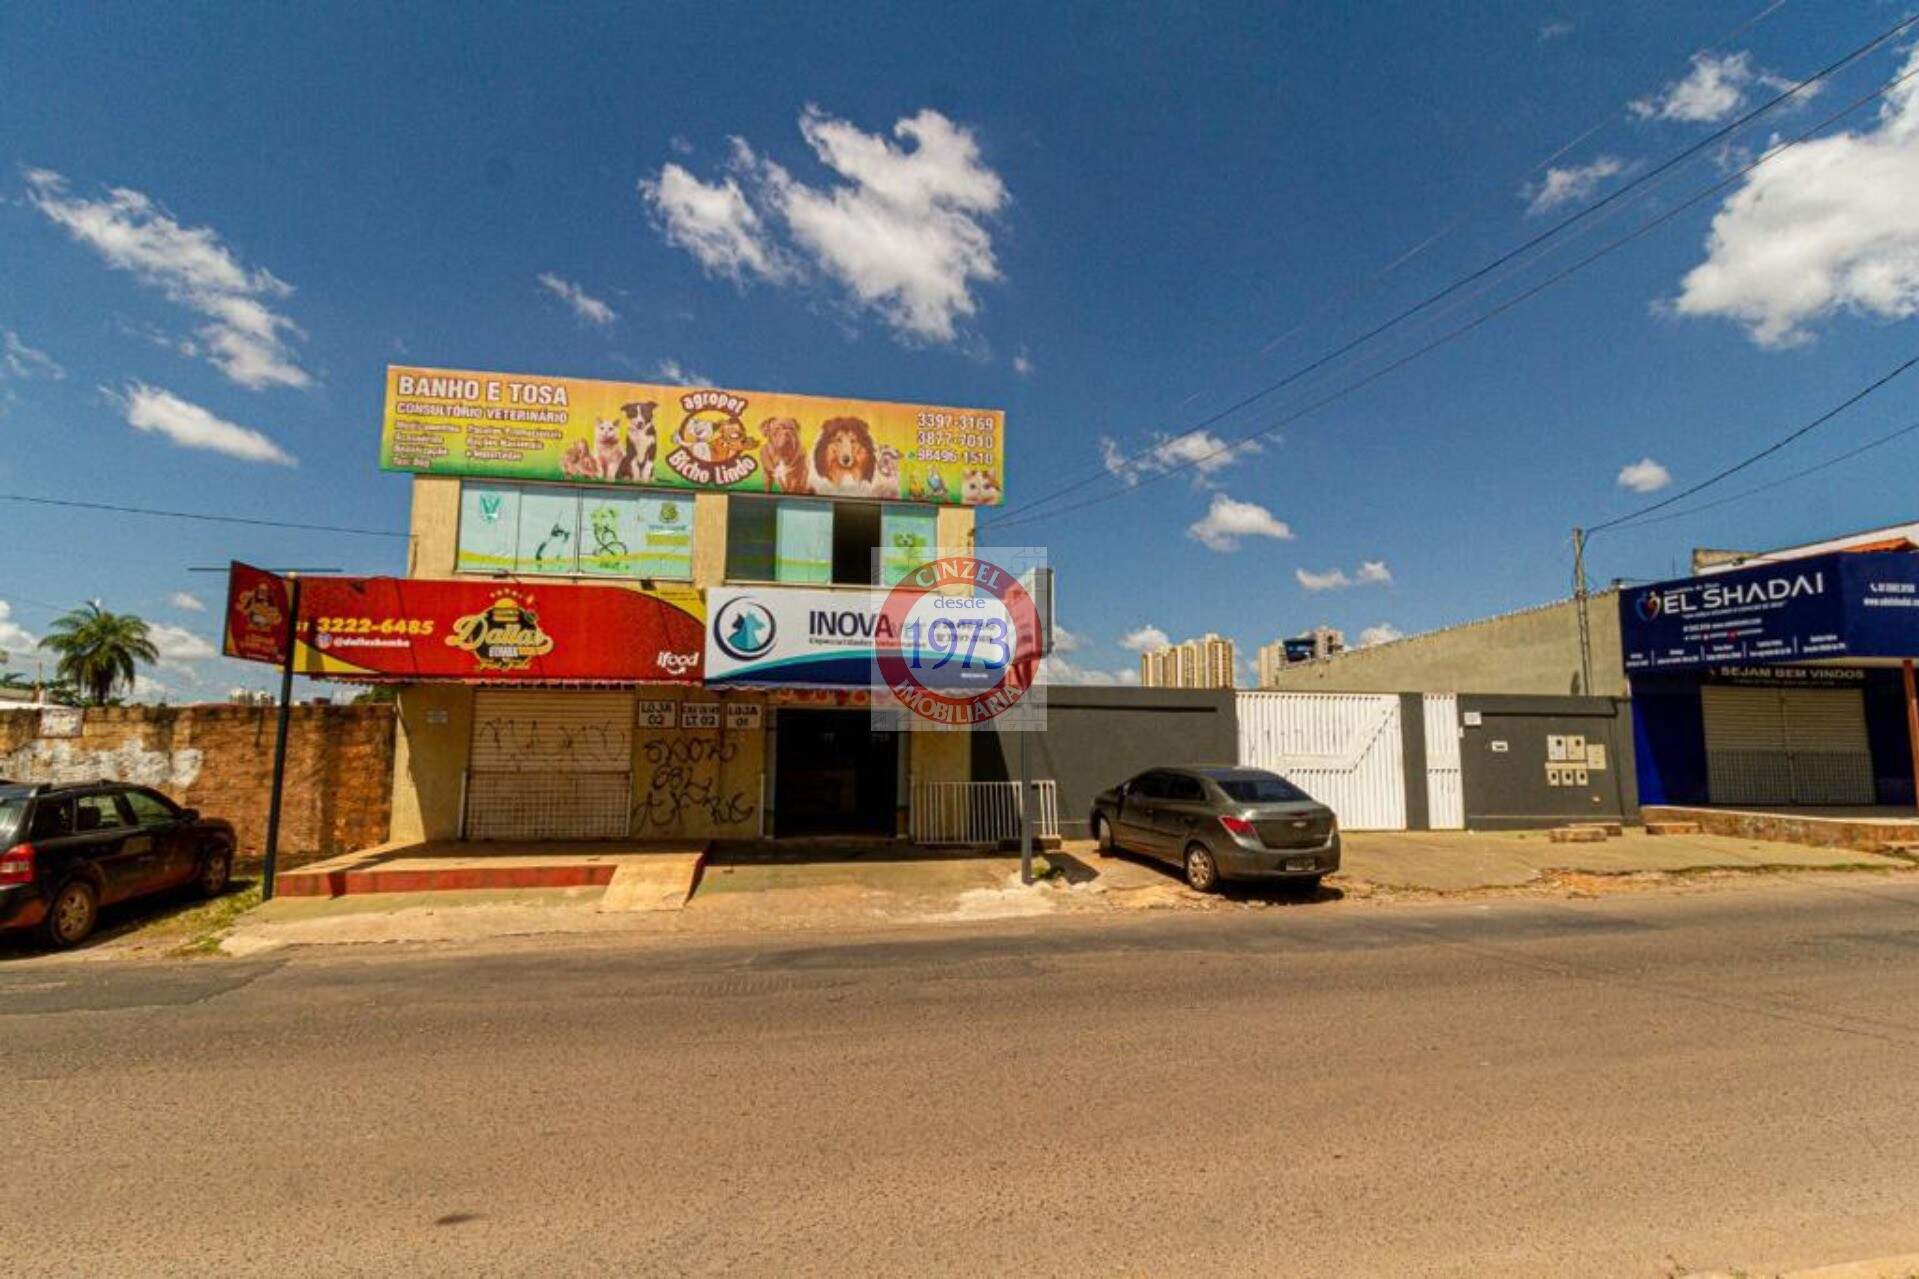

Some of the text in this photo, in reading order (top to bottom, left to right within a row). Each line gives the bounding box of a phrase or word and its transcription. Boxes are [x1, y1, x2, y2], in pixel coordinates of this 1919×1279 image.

[398, 375, 568, 405] BANHO E TOSA
[397, 402, 567, 425] CONSULTÓRIO VETERINÁRIO
[668, 451, 755, 484] Bicho Lindo
[1664, 594, 1697, 614] EL
[1703, 572, 1824, 609] SHADAI
[317, 617, 435, 635] 3222-6485
[809, 611, 894, 637] INOVA
[1721, 667, 1864, 679] SEJAM BEM VINDOS
